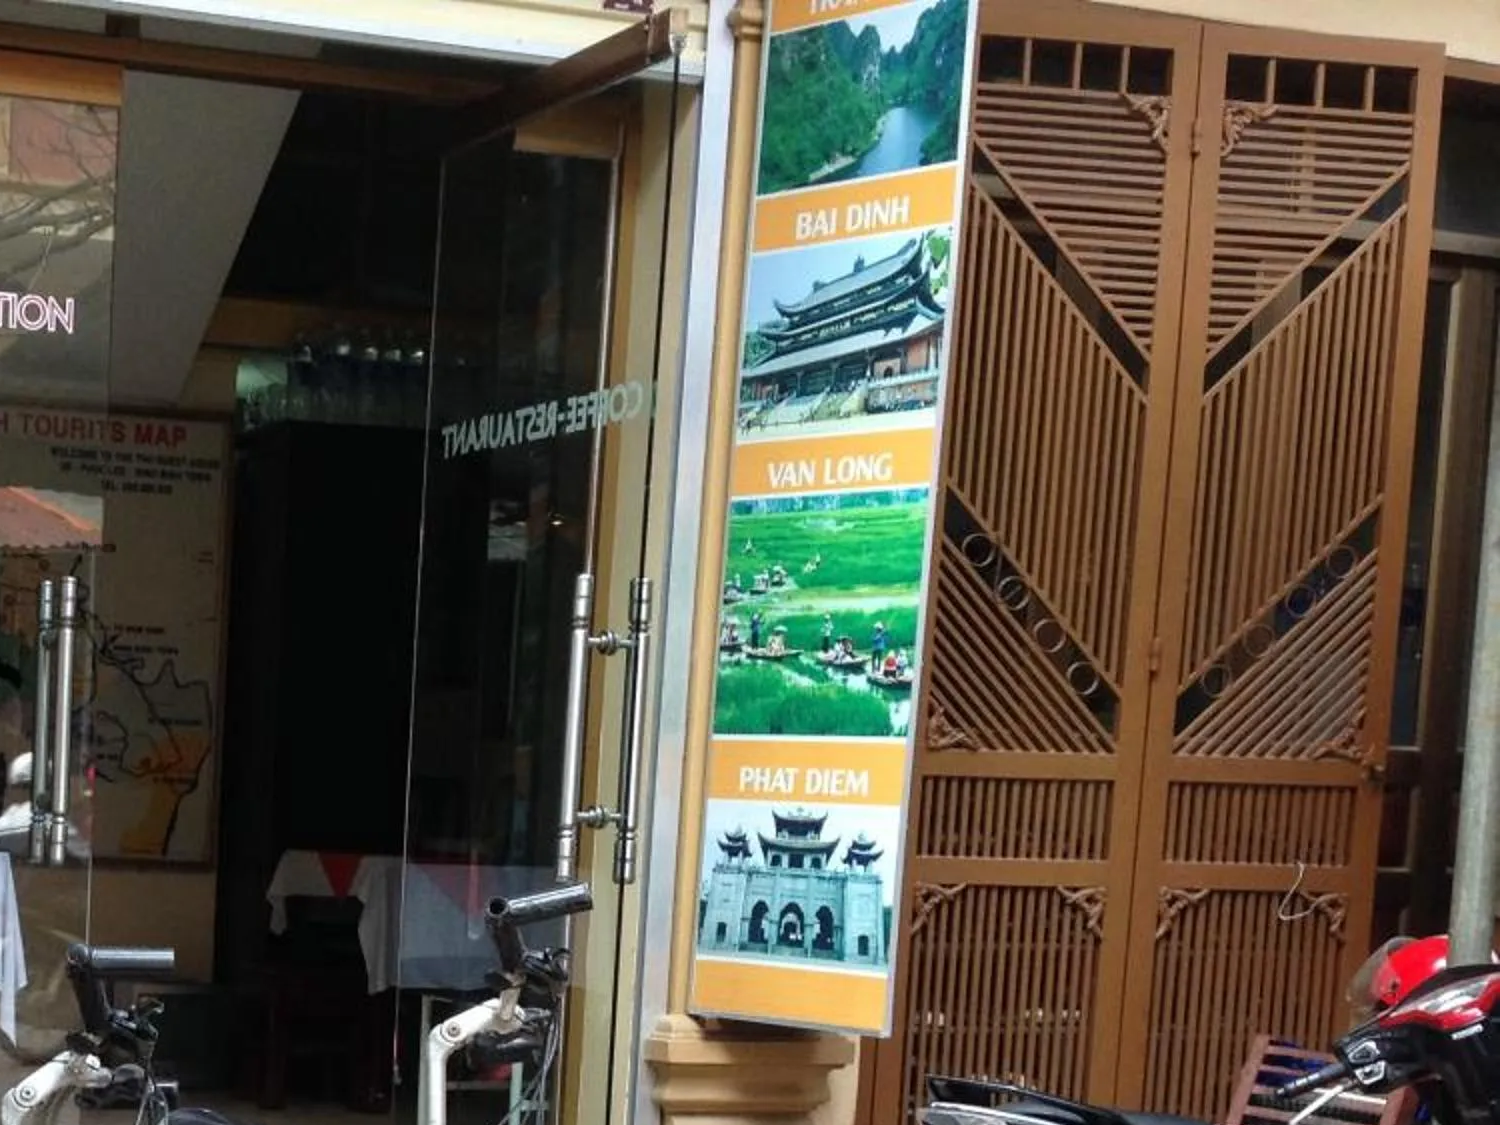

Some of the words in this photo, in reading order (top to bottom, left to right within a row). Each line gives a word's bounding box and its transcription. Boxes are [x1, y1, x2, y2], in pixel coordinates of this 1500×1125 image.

[795, 208, 838, 241] BAI
[846, 195, 910, 232] DINH
[133, 423, 188, 448] MAP
[767, 459, 820, 489] VAN
[823, 452, 894, 482] LONG
[739, 765, 797, 796] PHAT
[804, 767, 869, 798] DIEM
